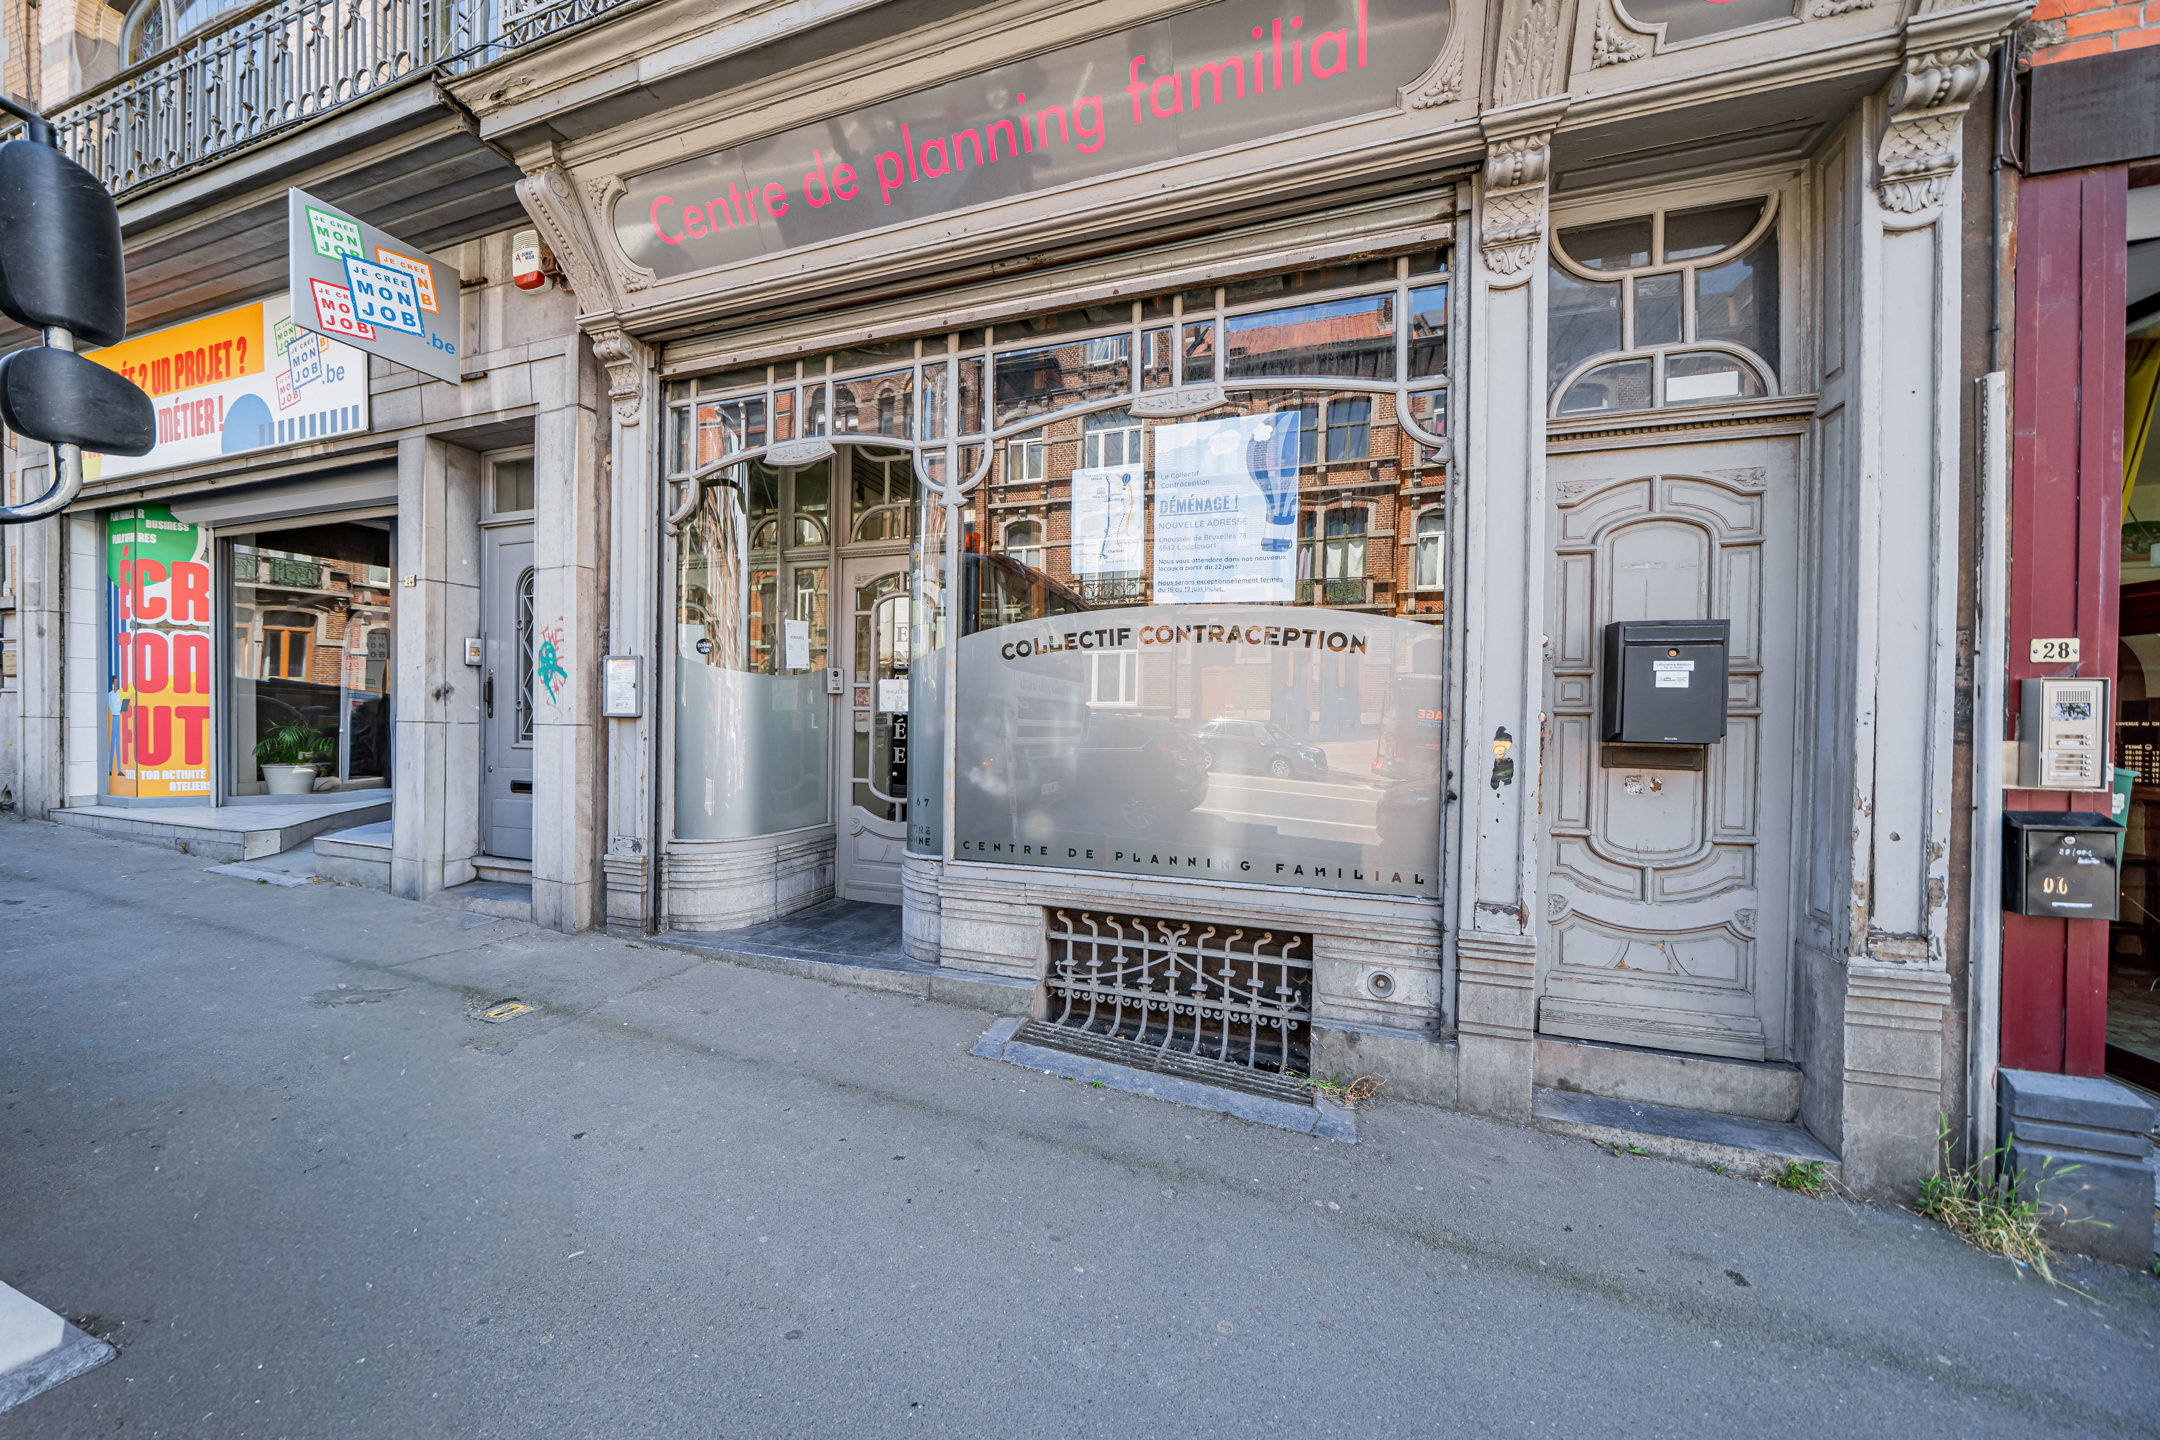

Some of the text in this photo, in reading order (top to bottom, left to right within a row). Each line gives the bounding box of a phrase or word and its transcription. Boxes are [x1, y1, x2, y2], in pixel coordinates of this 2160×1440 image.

[650, 0, 1368, 246] Centre de planning familial
[314, 215, 355, 233] JE CRÉE
[316, 225, 358, 247] MON
[383, 257, 395, 265] JE
[353, 267, 369, 276] JE
[375, 272, 408, 288] CRÉE
[318, 288, 349, 300] JE CR
[356, 279, 412, 307] MON
[321, 298, 350, 314] MO
[362, 302, 417, 327] JOB
[325, 315, 370, 334] JOB
[426, 332, 456, 355] .be
[293, 347, 316, 367] MON
[151, 357, 172, 395] UN
[175, 339, 232, 390] PROJET
[295, 362, 318, 382] JOB
[322, 364, 345, 384] .be
[280, 383, 291, 394] MO
[159, 396, 214, 444] MÉTIER
[1161, 479, 1210, 488] Contraception
[1171, 471, 1199, 479] Collectif
[1160, 495, 1230, 514] DÉMÉNAGE
[146, 520, 189, 531] BUSINESS
[1159, 518, 1247, 529] NOUVELLE ADRESSE
[1159, 535, 1191, 543] Chaussée
[1185, 564, 1202, 572] partir
[119, 545, 209, 622] ÉCR
[1196, 577, 1258, 585] exceptionnellement
[1001, 624, 1368, 661] COLLECTIF CONTRACEPTION
[2043, 642, 2069, 659] 28
[118, 632, 209, 694] TON
[122, 705, 210, 766] FUT
[140, 770, 160, 780] TON
[162, 768, 206, 779] ACTIVITÉ
[962, 840, 1425, 886] CENTRE DE PLANNING FAMILIAL
